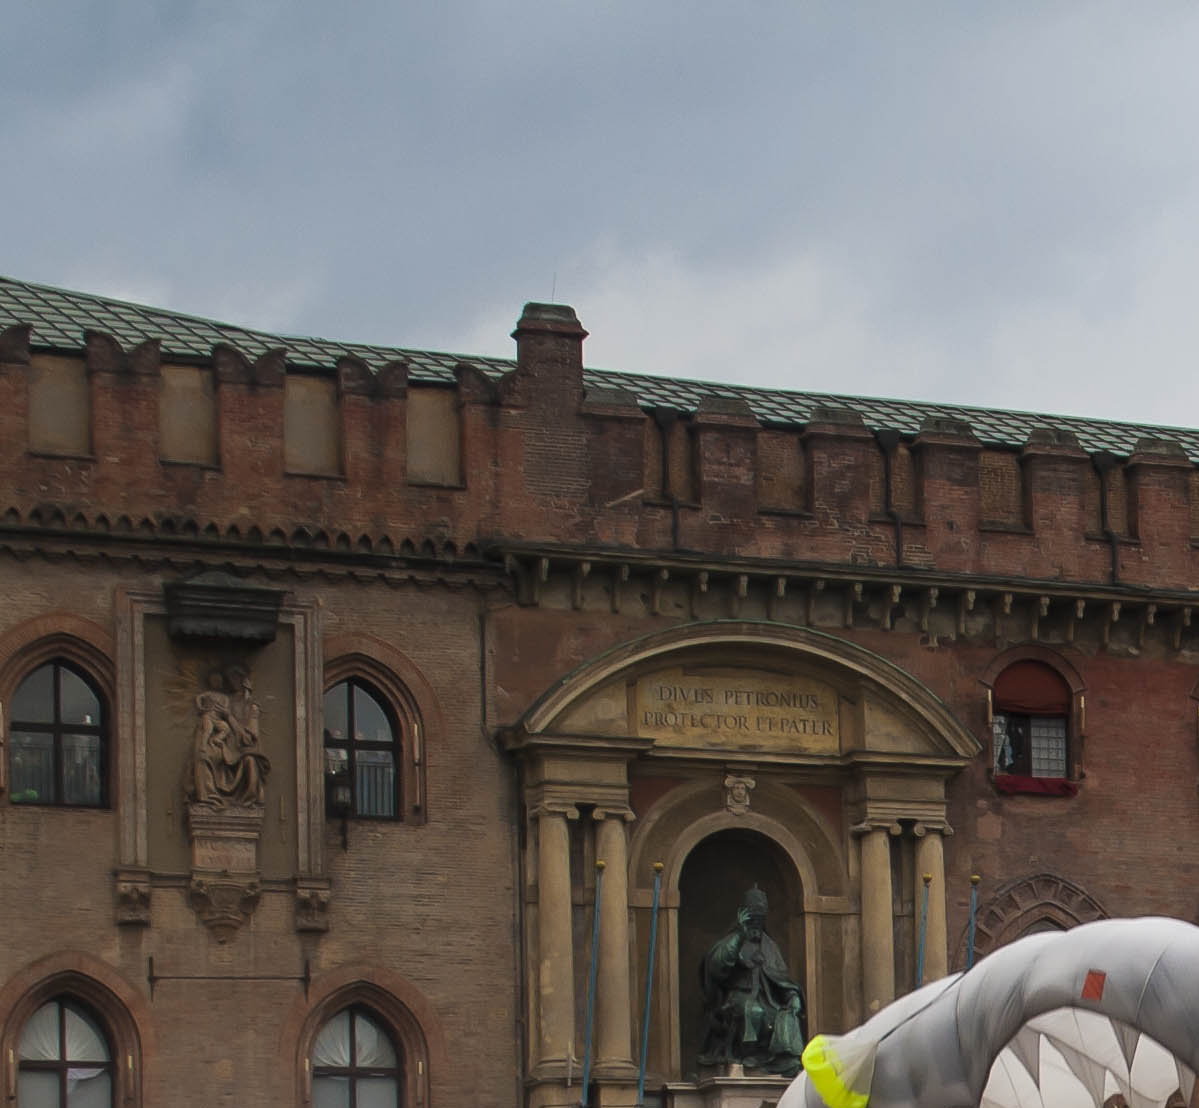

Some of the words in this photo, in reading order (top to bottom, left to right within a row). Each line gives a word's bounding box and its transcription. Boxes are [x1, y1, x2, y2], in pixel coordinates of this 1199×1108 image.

[724, 690, 818, 710] PETRONIUS
[644, 711, 749, 730] PROTECTOR
[756, 716, 776, 731] ET
[780, 718, 833, 736] PATER
